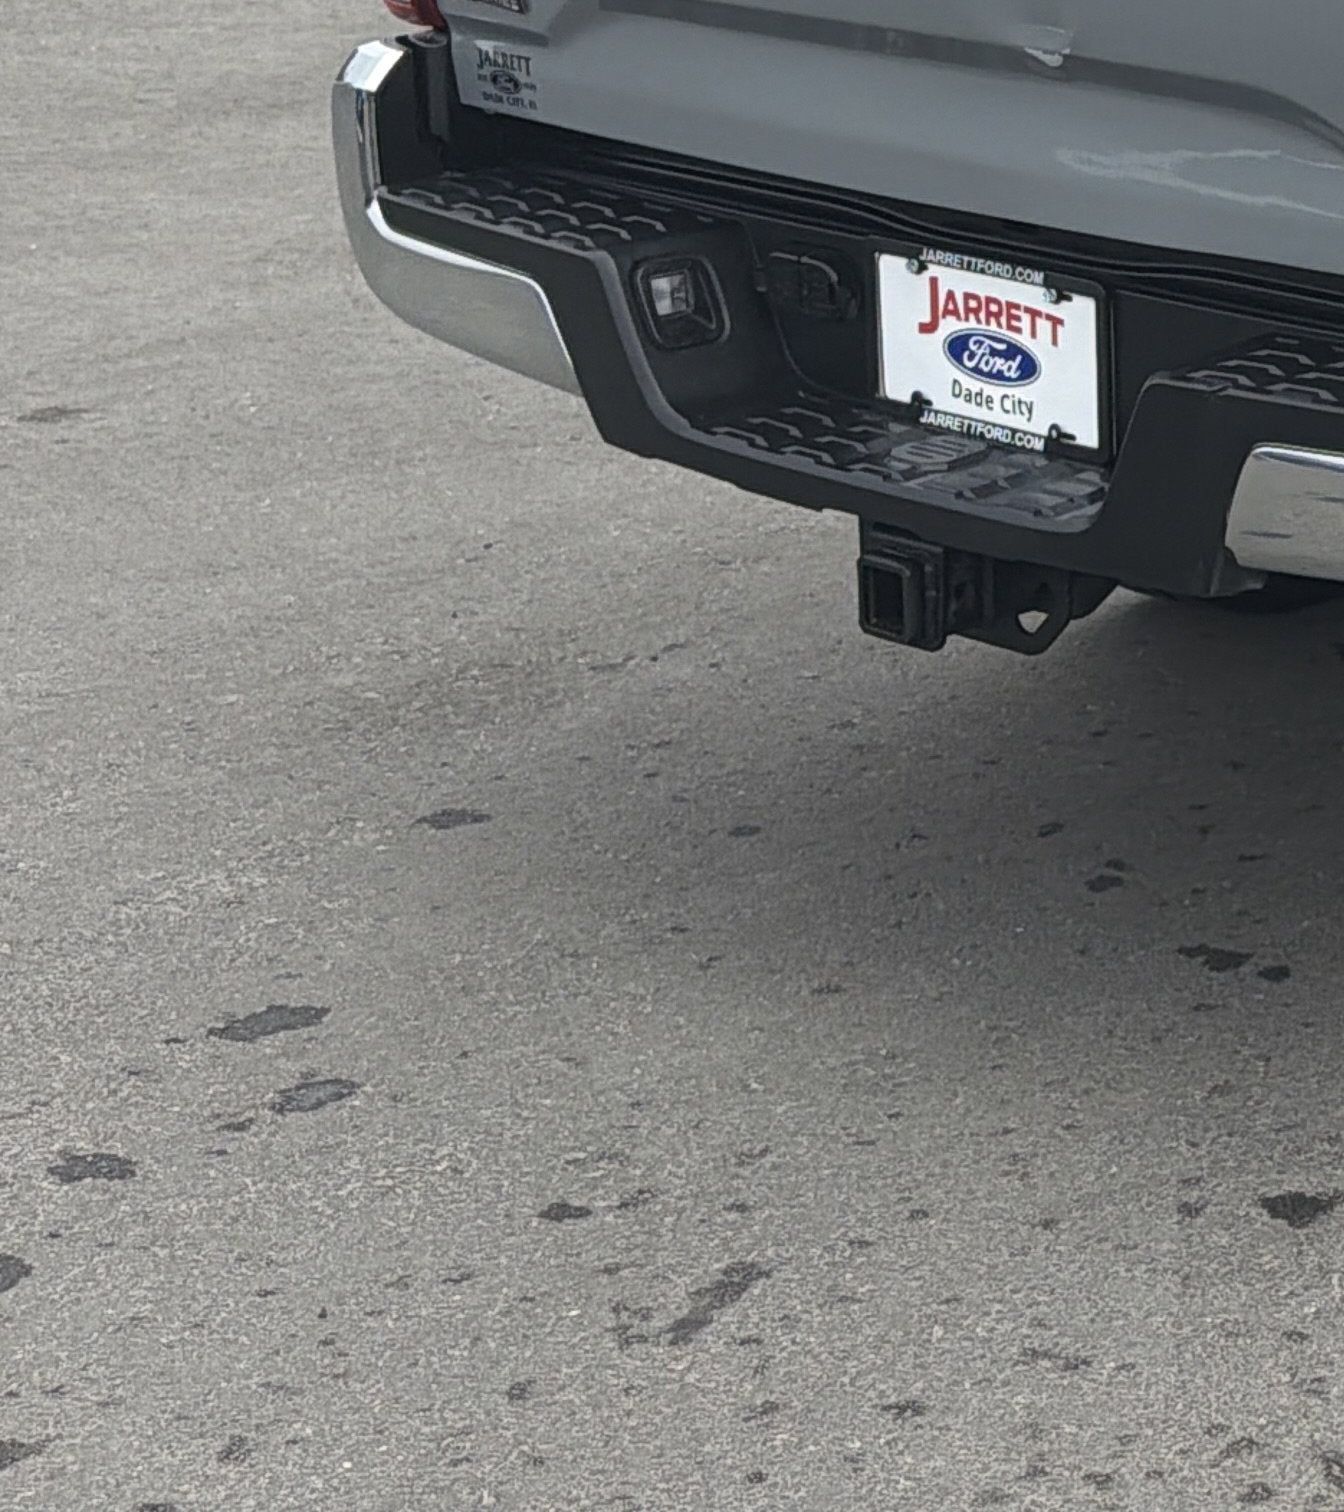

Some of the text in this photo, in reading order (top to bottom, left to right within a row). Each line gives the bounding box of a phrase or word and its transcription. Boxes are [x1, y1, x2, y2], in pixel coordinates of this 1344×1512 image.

[477, 48, 532, 76] JARRETT
[919, 247, 1045, 285] JARRETTFORD.COM
[918, 276, 1065, 348] JARRETT
[962, 336, 1023, 379] Ford
[952, 379, 1035, 423] Dade City
[919, 410, 1045, 452] JARRETTFORD.COM
